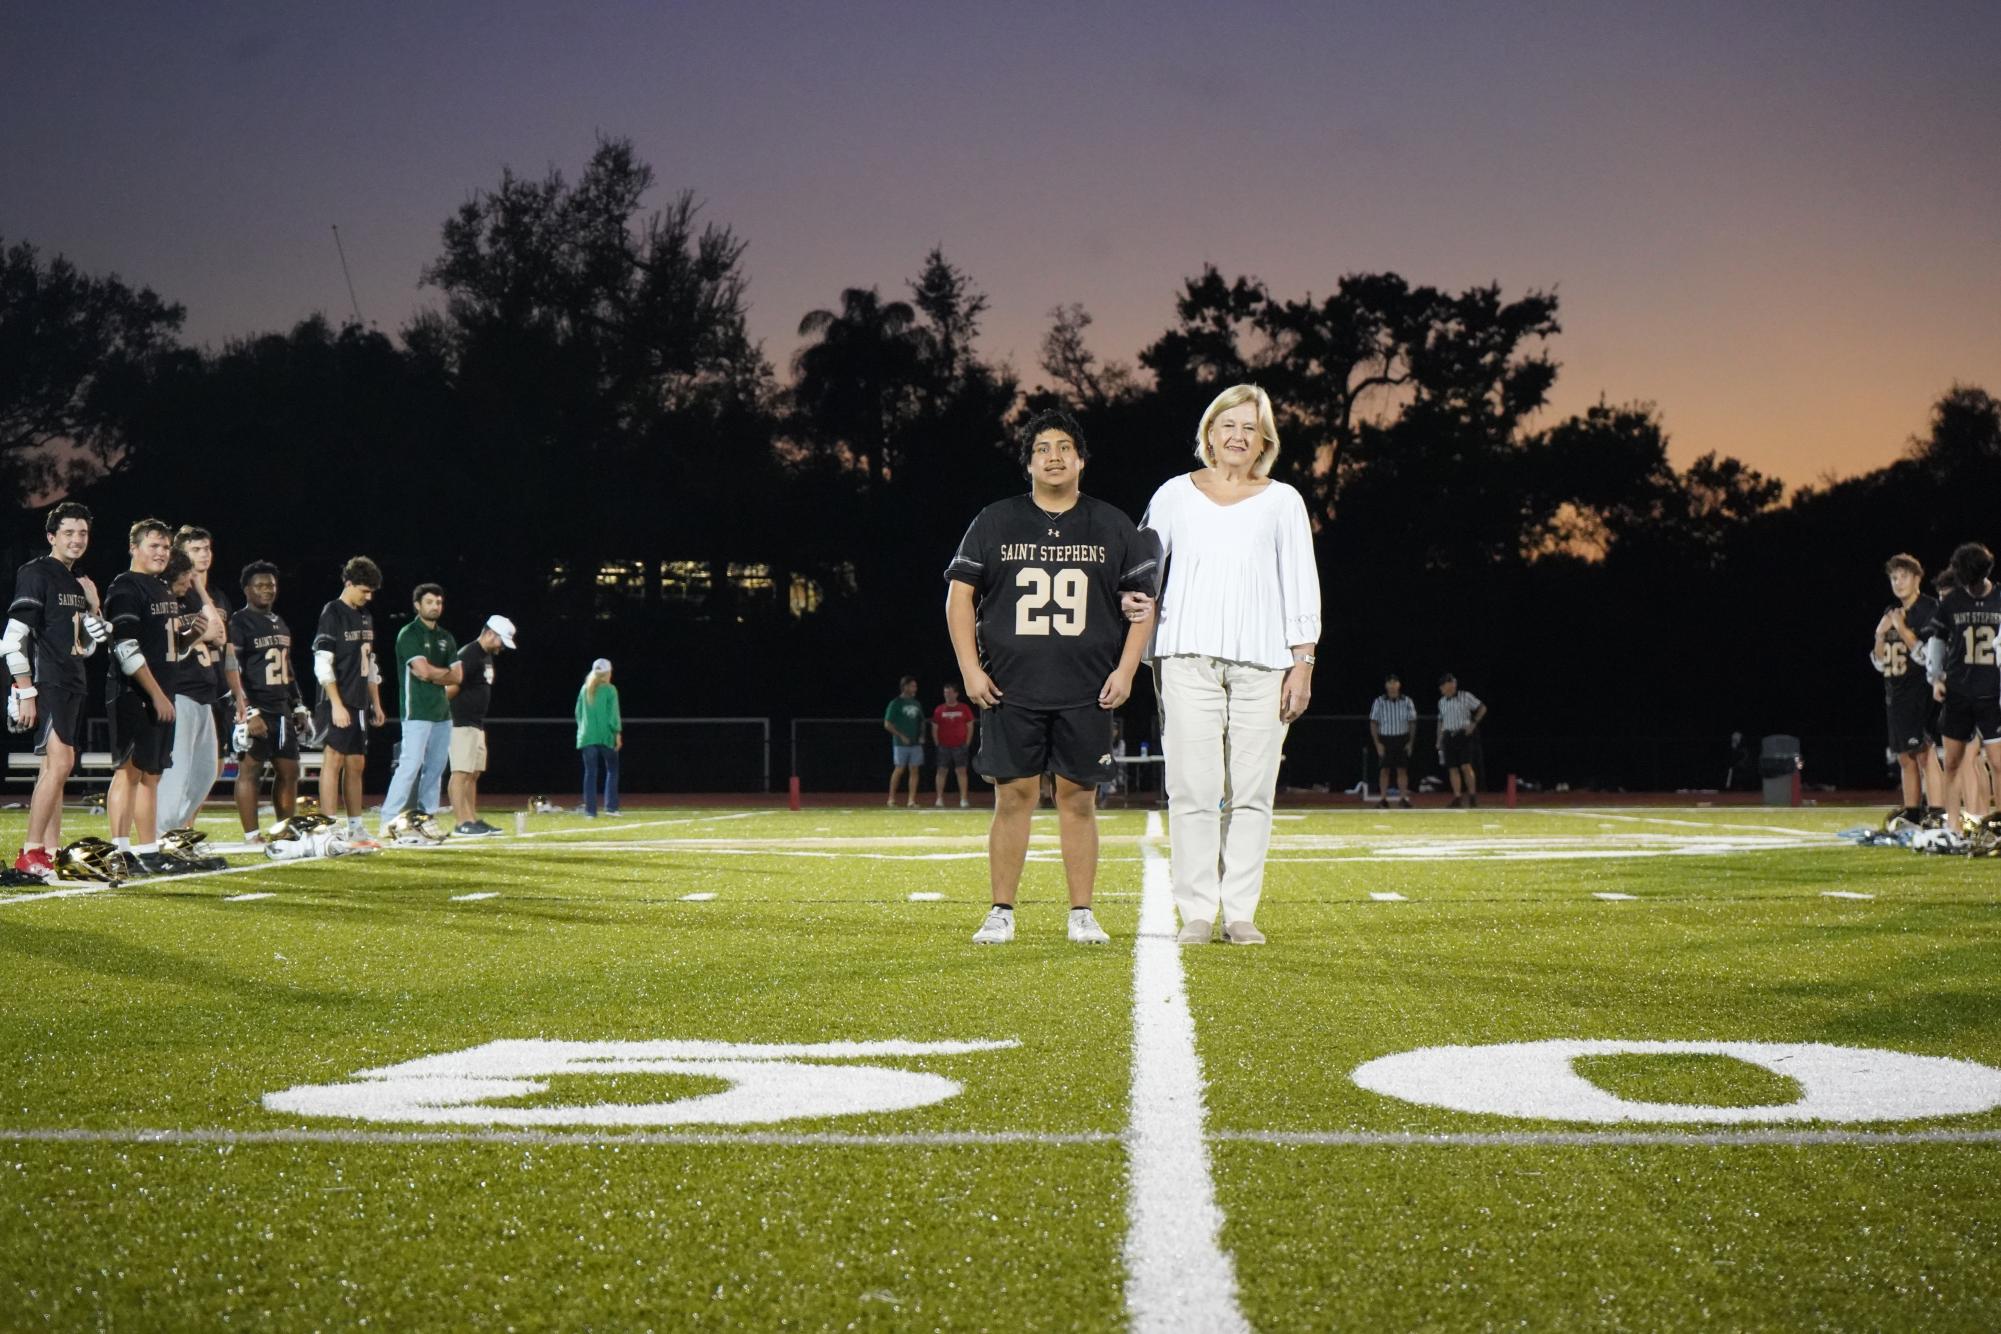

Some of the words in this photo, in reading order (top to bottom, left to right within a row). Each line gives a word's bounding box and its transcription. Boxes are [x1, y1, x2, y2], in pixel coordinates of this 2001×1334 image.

[1001, 543, 1037, 562] SAINT
[58, 593, 78, 607] SAINT
[150, 601, 169, 615] SAINT
[1015, 567, 1089, 636] 29
[253, 635, 273, 649] SAINT
[1963, 625, 1996, 665] 12
[262, 1038, 1021, 1125] 5
[1350, 1038, 2001, 1124] 0
